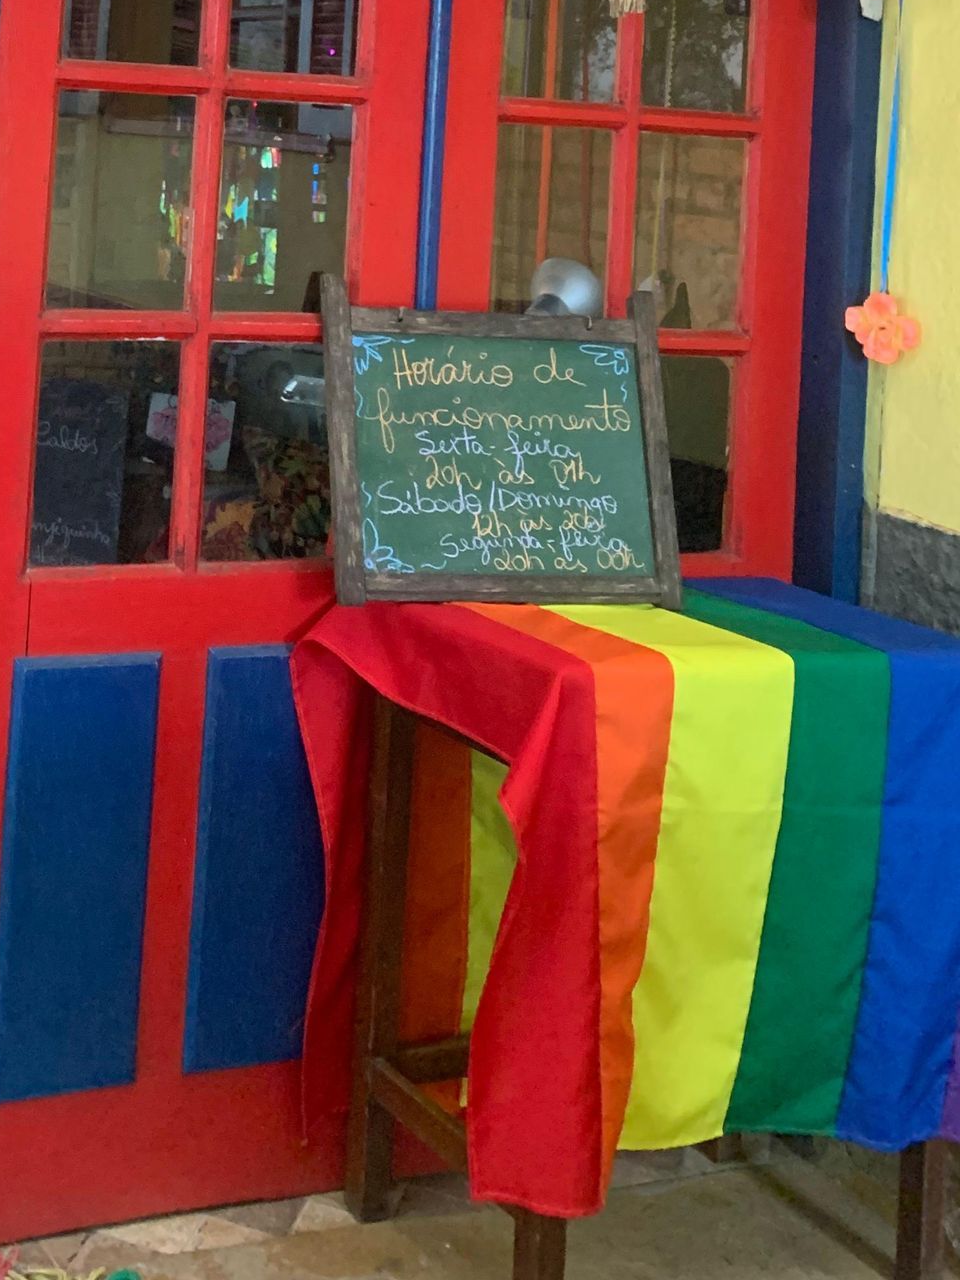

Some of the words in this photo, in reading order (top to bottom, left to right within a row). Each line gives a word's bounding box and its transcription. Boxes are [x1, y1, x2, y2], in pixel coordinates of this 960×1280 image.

[393, 346, 513, 389] Horário
[533, 347, 586, 387] de
[364, 387, 632, 454] funcionamento
[426, 455, 482, 491] 20h
